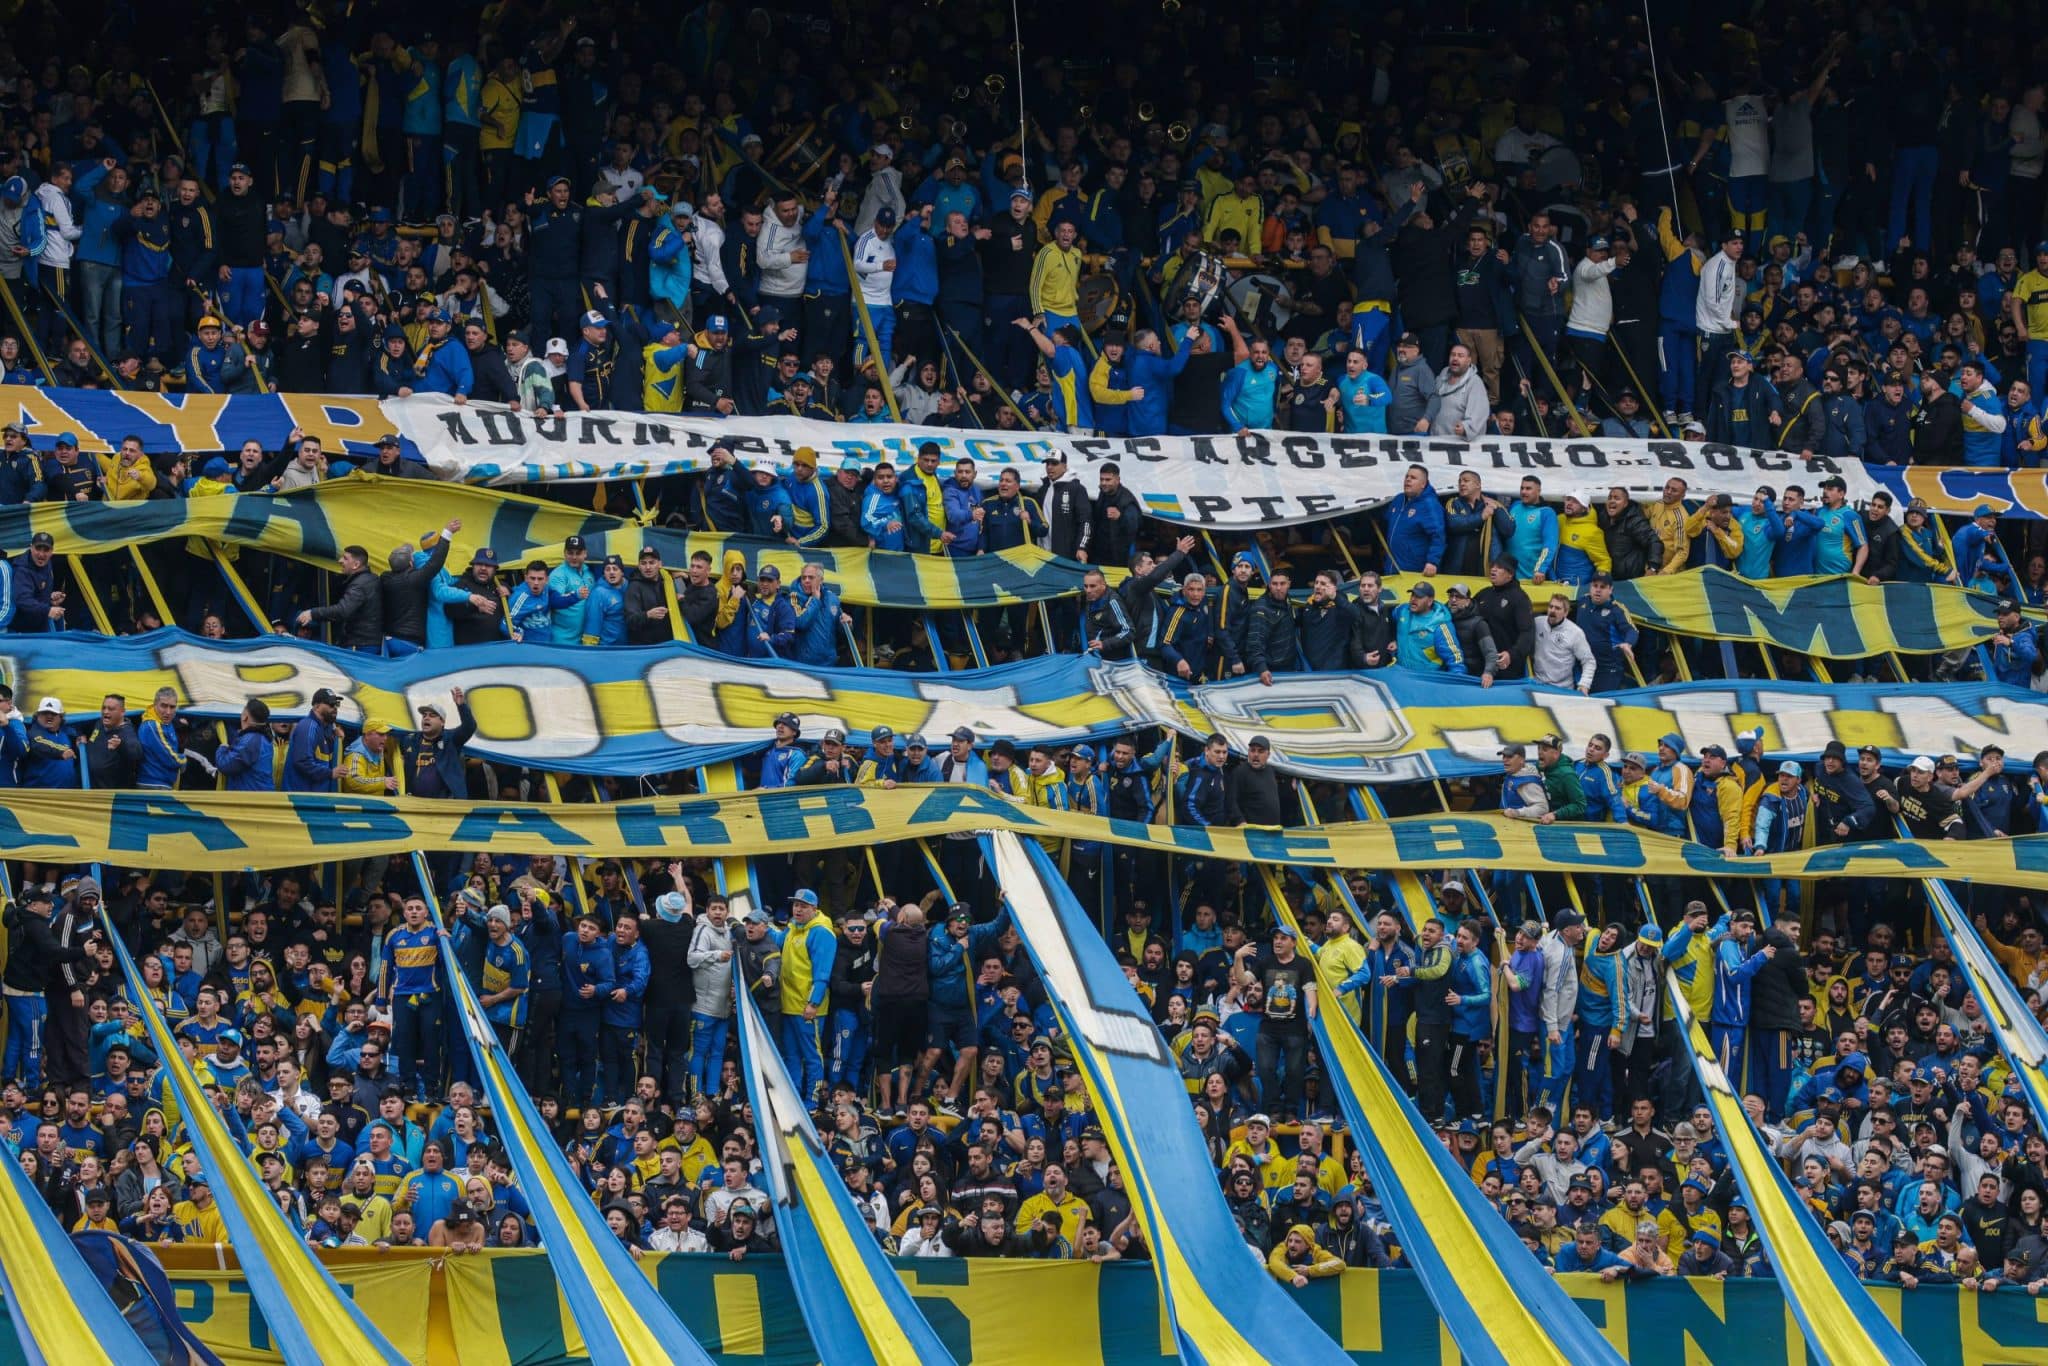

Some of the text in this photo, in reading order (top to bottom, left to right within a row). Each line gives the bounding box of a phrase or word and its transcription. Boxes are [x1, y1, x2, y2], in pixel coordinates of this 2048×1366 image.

[1190, 433, 1609, 469] ARGENTINO
[1648, 441, 1843, 474] BOCA
[158, 642, 1092, 762] BOCA
[1390, 818, 1949, 876] BOCA
